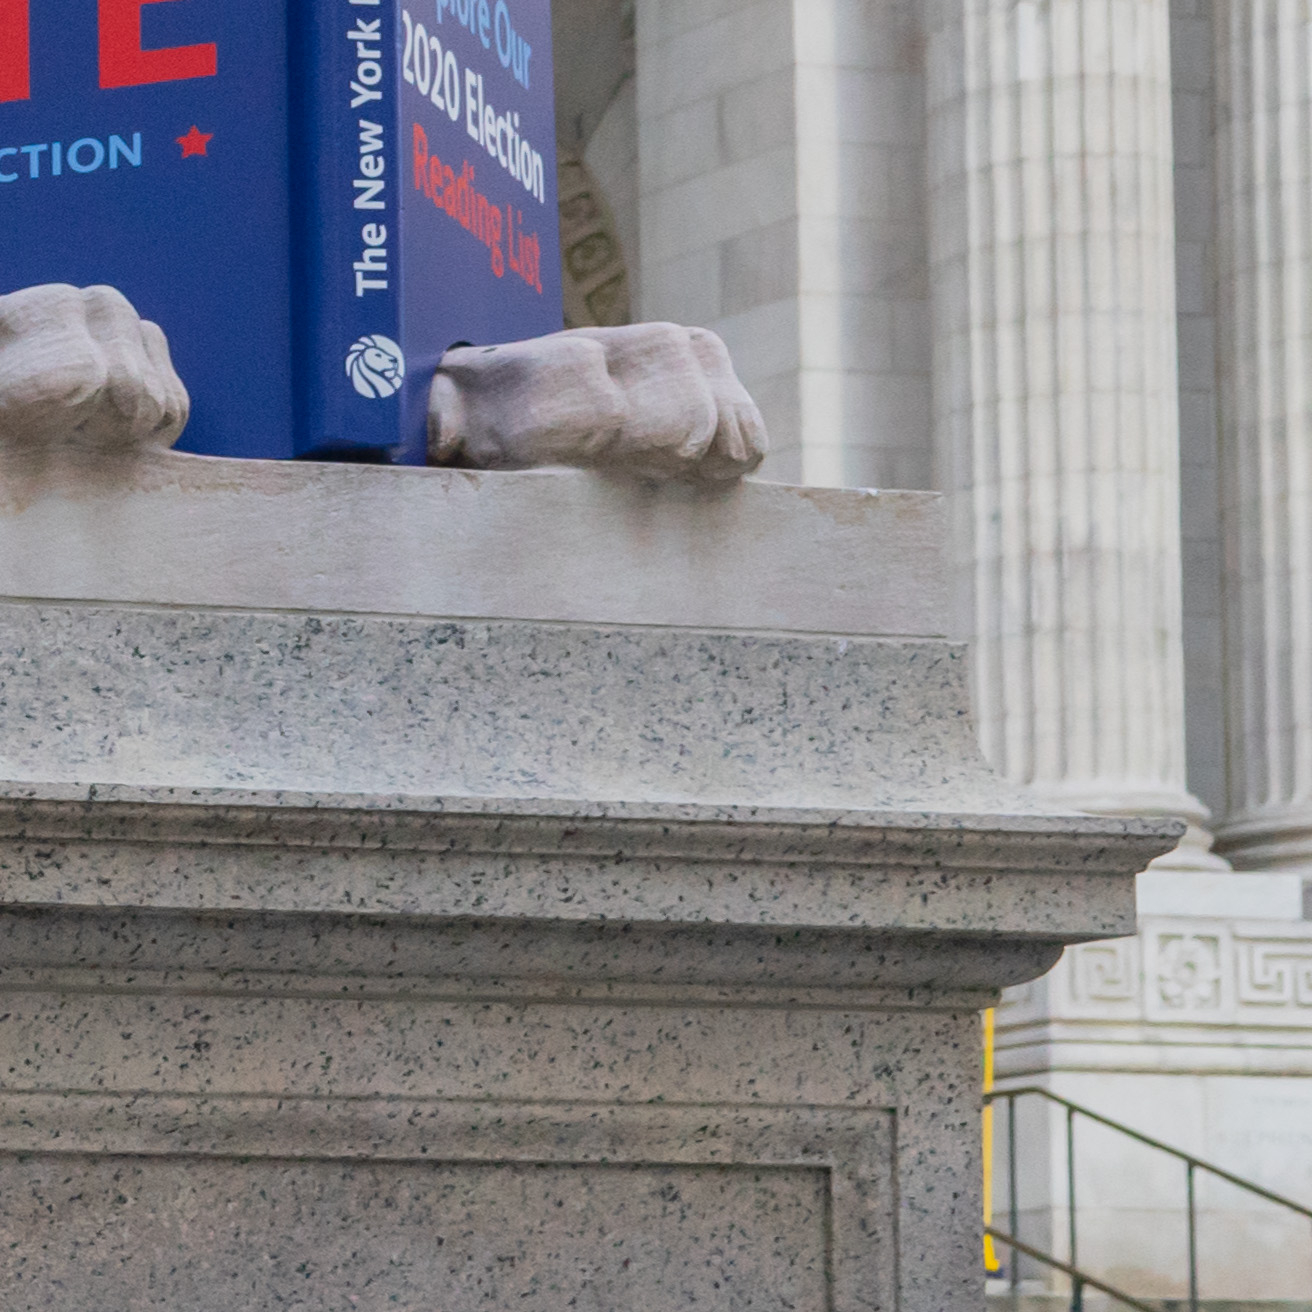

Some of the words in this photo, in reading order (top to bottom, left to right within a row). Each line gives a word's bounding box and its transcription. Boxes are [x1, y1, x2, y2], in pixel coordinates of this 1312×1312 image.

[347, 19, 385, 111] York
[402, 9, 460, 122] 2020
[466, 66, 545, 204] Election
[352, 119, 388, 212] New
[413, 122, 504, 279] Reading
[508, 204, 543, 294] List
[353, 222, 388, 297] The
